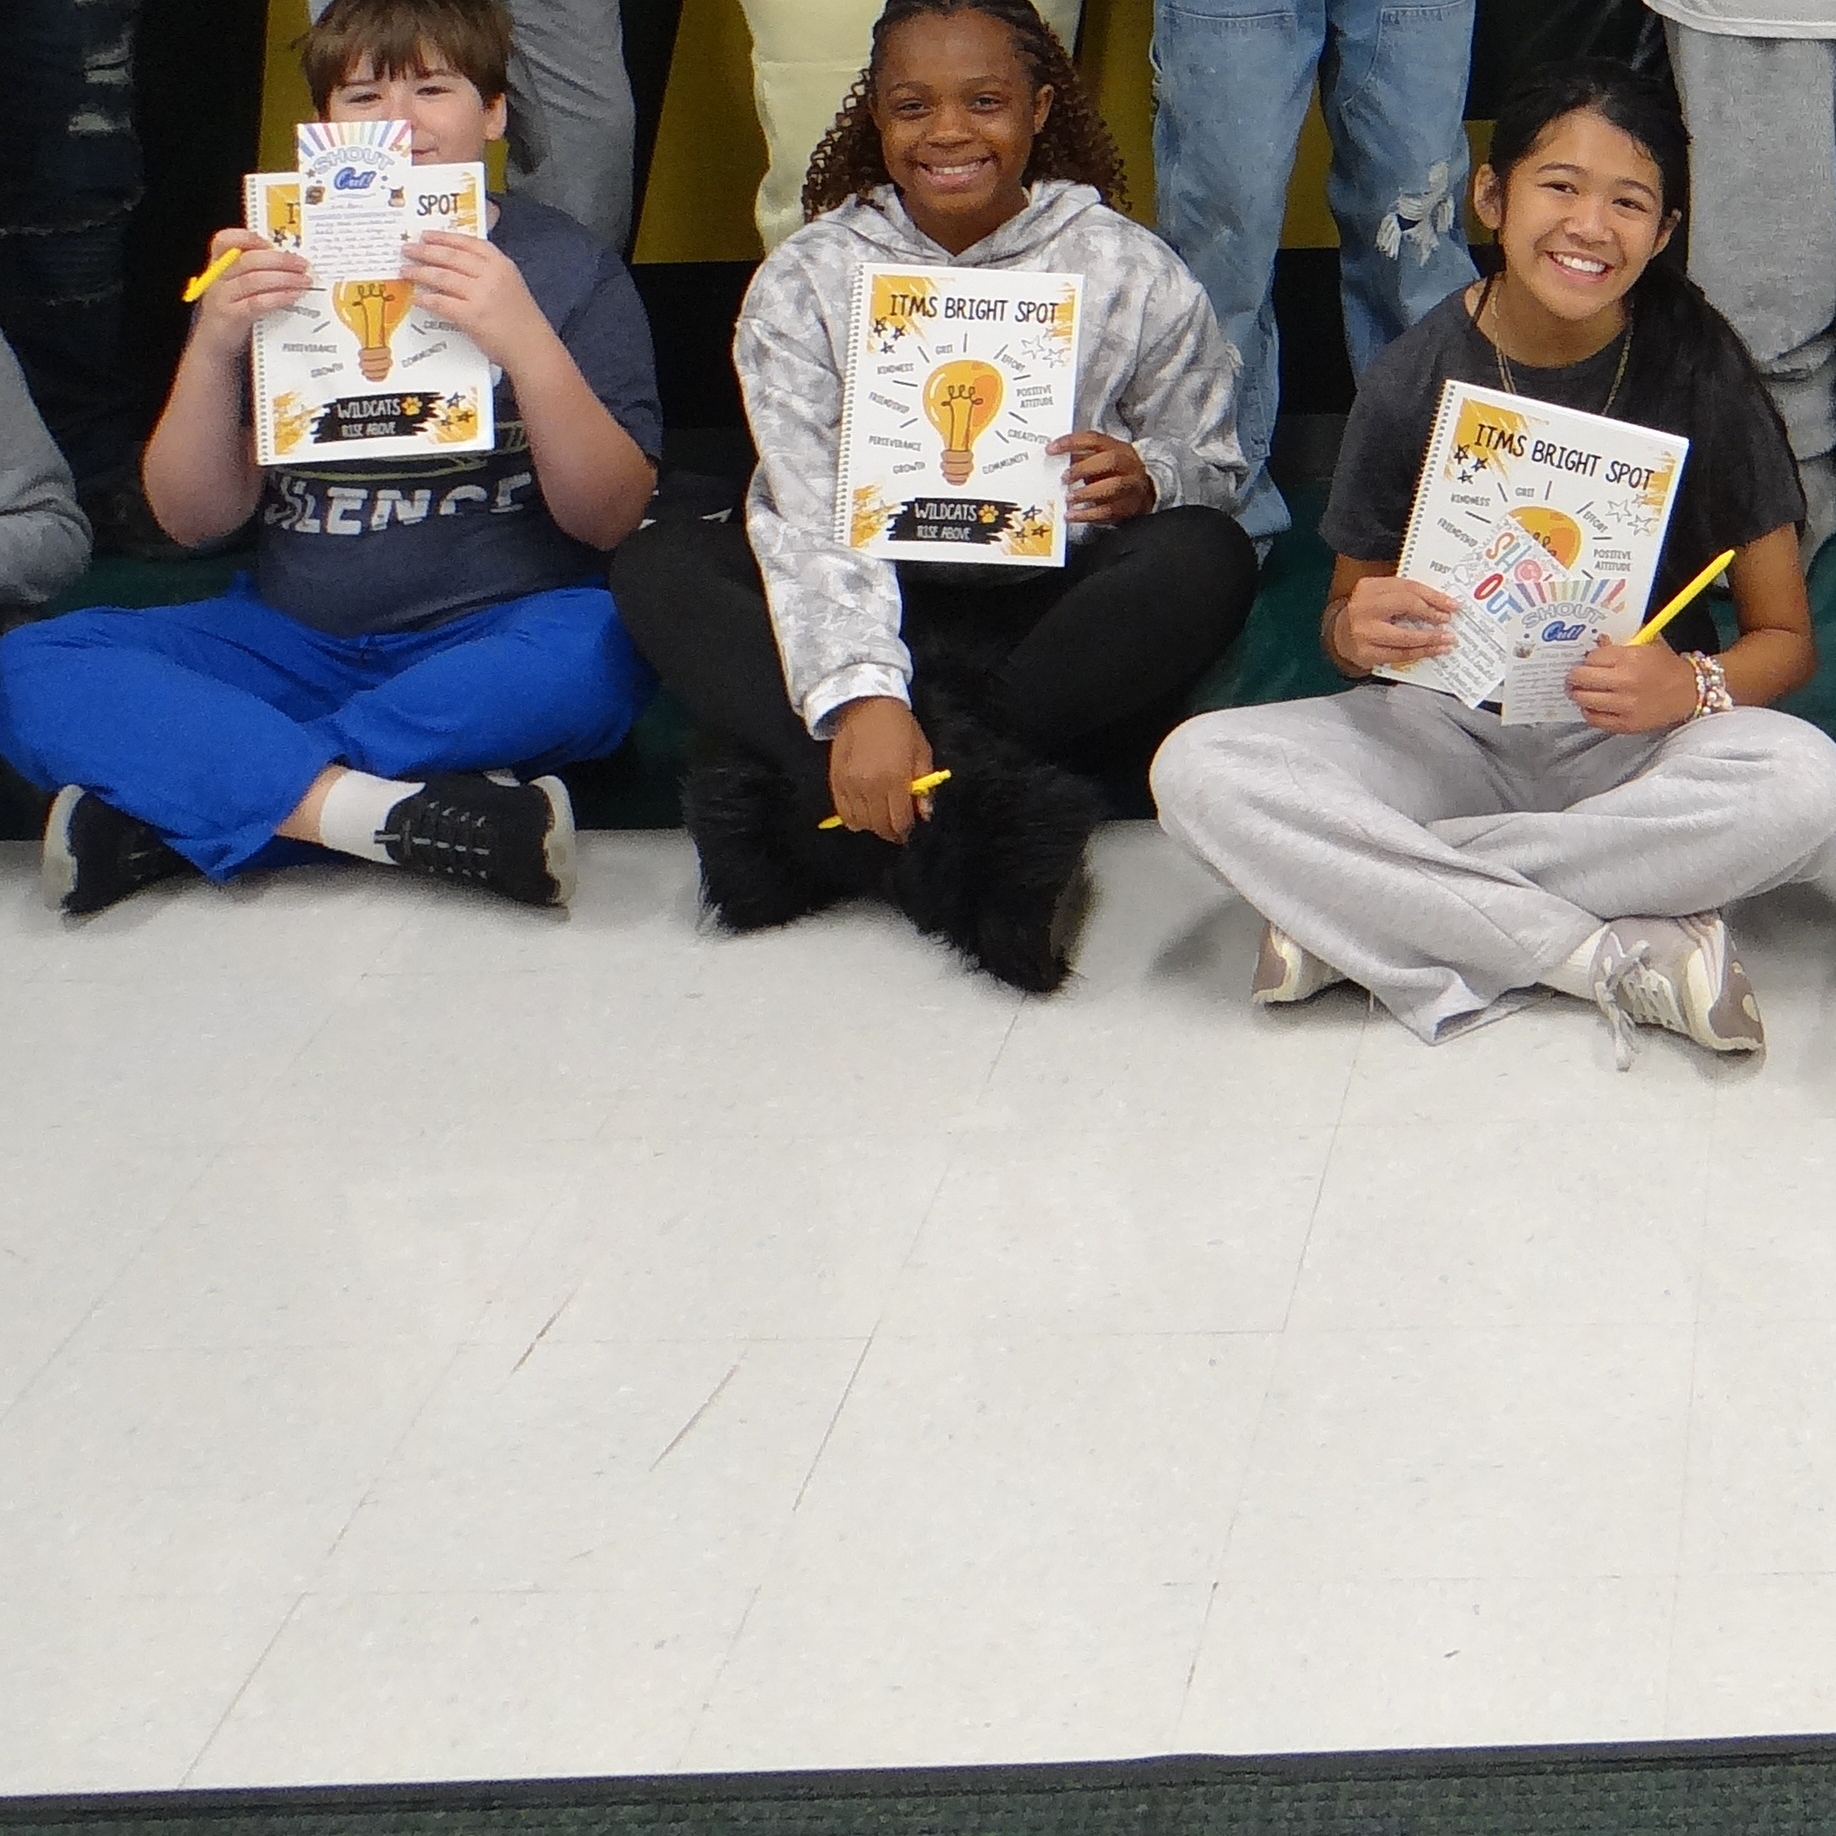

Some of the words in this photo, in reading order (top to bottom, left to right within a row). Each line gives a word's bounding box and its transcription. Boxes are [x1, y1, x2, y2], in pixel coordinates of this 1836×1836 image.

[313, 146, 395, 174] SHOUT
[417, 193, 459, 216] SPOT
[889, 294, 938, 318] ITMS
[945, 297, 1009, 322] BRIGHT
[1014, 301, 1058, 324] SPOT
[1016, 384, 1052, 397] POSITIVE
[337, 399, 401, 419] WILDCATS
[868, 435, 922, 453] PERSEVERANCE
[892, 461, 926, 475] GROWTH
[982, 452, 1030, 475] COMMUNITY
[1474, 423, 1527, 457] ITMS
[1532, 439, 1602, 478] BRIGHT
[1605, 460, 1655, 492] SPOT
[1450, 493, 1492, 507] KINDNESS
[1515, 487, 1535, 499] GRIT
[914, 501, 978, 523] WILDCATS
[1582, 510, 1608, 534] EFFORT
[917, 525, 940, 540] RISE
[941, 526, 971, 541] ABOVE
[1437, 517, 1479, 548] FRIENDSHIP
[1593, 548, 1632, 561] POSITIVE
[1594, 560, 1632, 573] ATTITUDE
[1522, 602, 1606, 629] SHOUT
